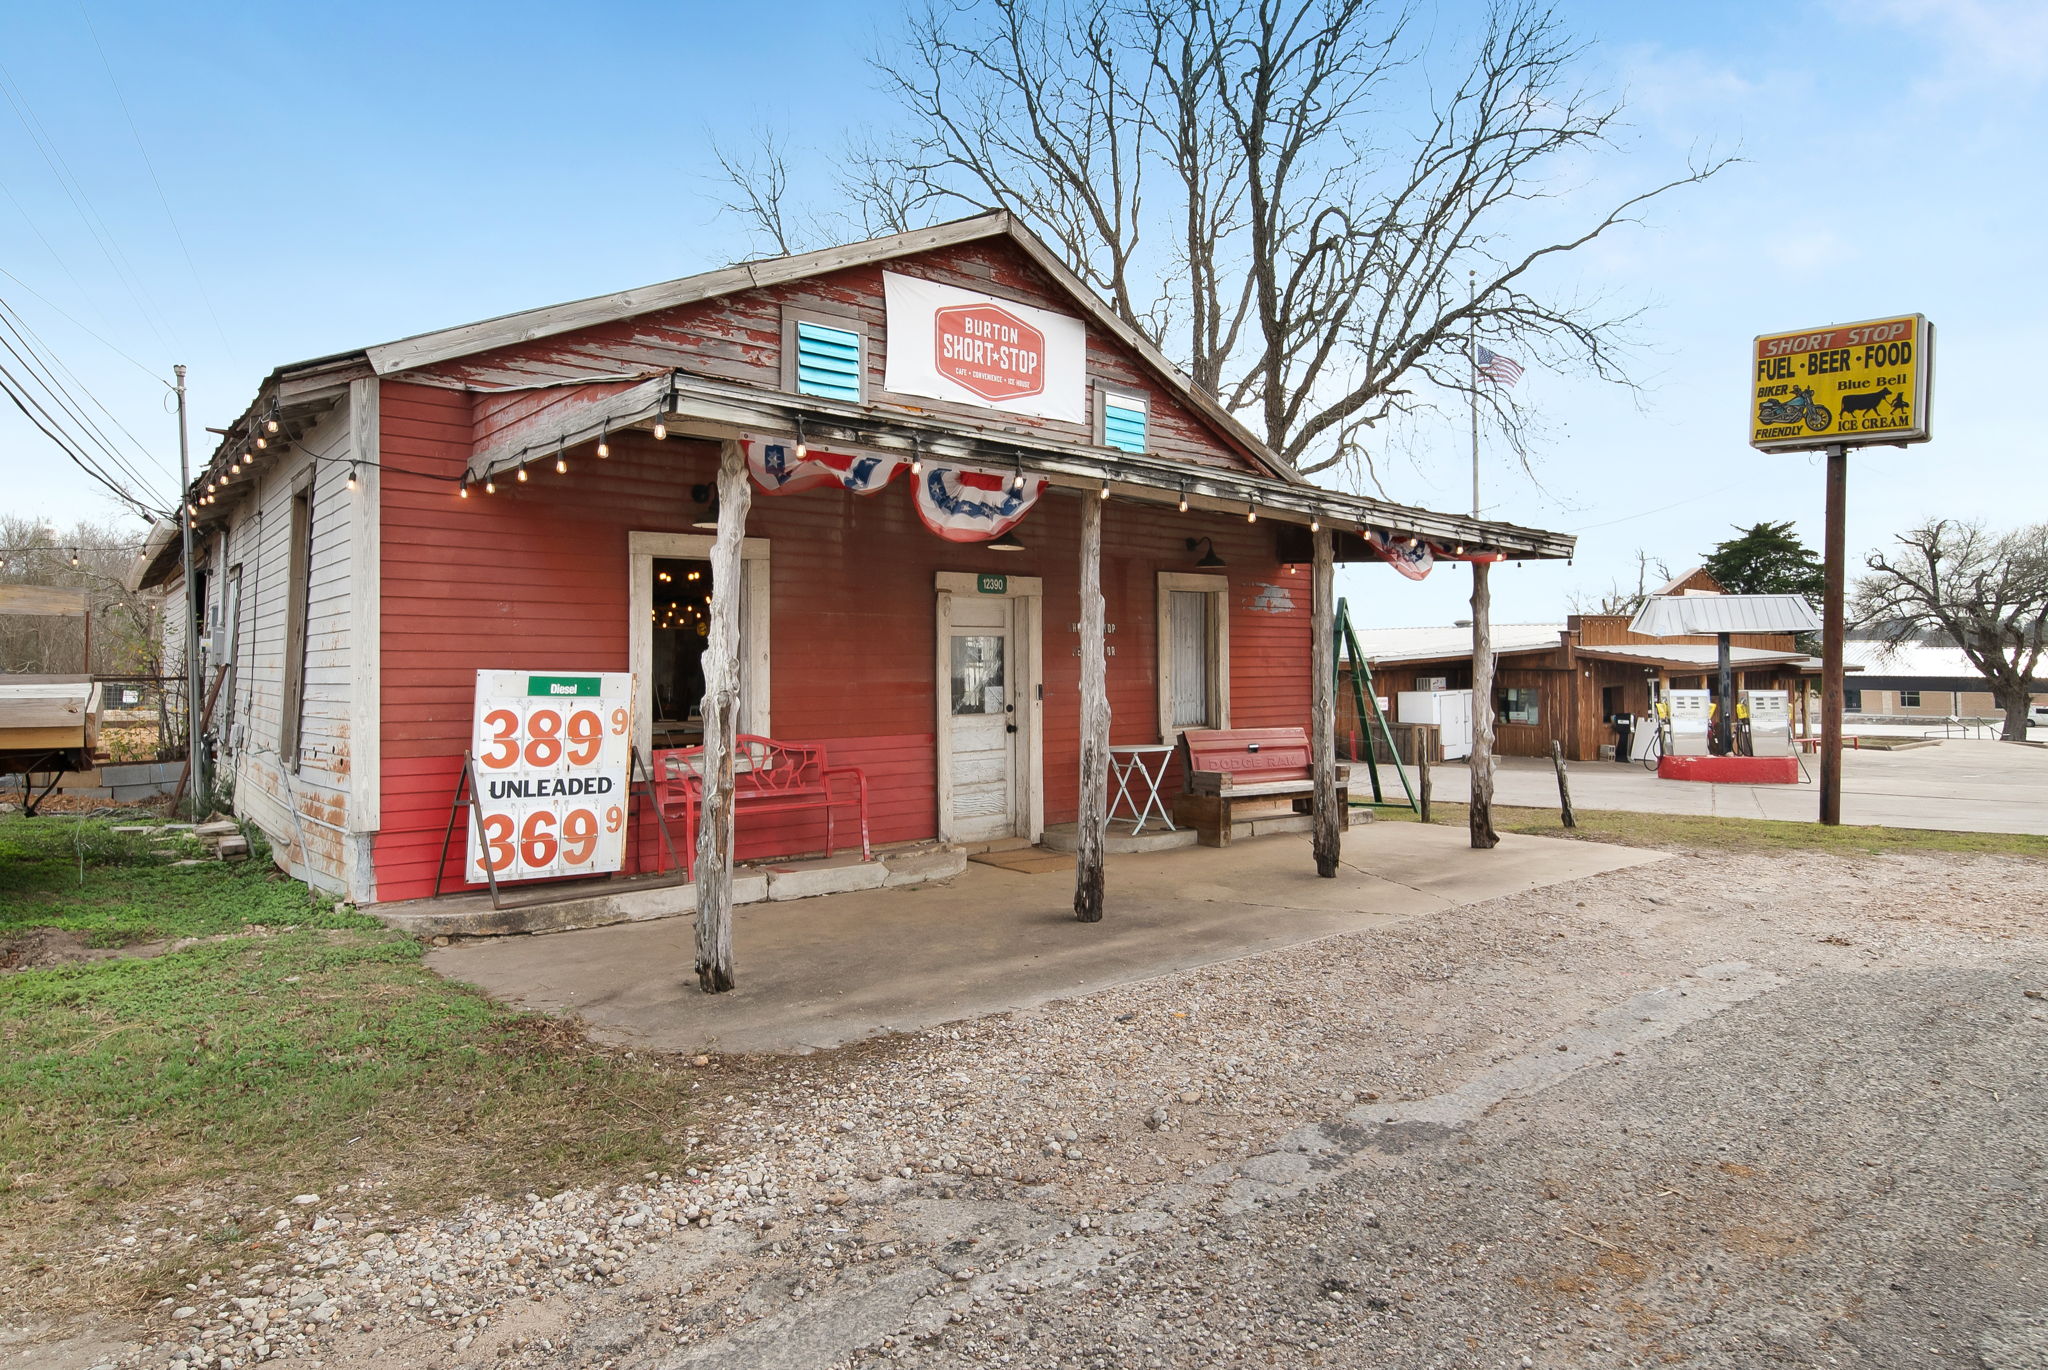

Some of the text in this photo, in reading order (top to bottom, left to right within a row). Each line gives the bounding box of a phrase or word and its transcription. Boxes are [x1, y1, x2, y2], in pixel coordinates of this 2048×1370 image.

[965, 317, 1018, 344] BURTON
[1765, 323, 1905, 356] SHORT STOP
[943, 333, 1038, 375] SHORT STOP
[1757, 341, 1912, 382] FUEL BEER FOOD
[955, 367, 967, 376] CAFE
[972, 370, 1002, 383] CONVENIENCE
[1837, 374, 1907, 391] Blue Bell
[1757, 384, 1788, 398] BIKER
[1838, 415, 1909, 431] ICE CREAM
[1755, 425, 1803, 439] FRIENDLY
[983, 578, 1003, 590] 12390
[550, 684, 578, 695] Diesel
[480, 709, 603, 769] 389
[1209, 755, 1297, 770] DODGE RAM
[490, 776, 613, 799] UNLEADED
[475, 808, 599, 871] 369
